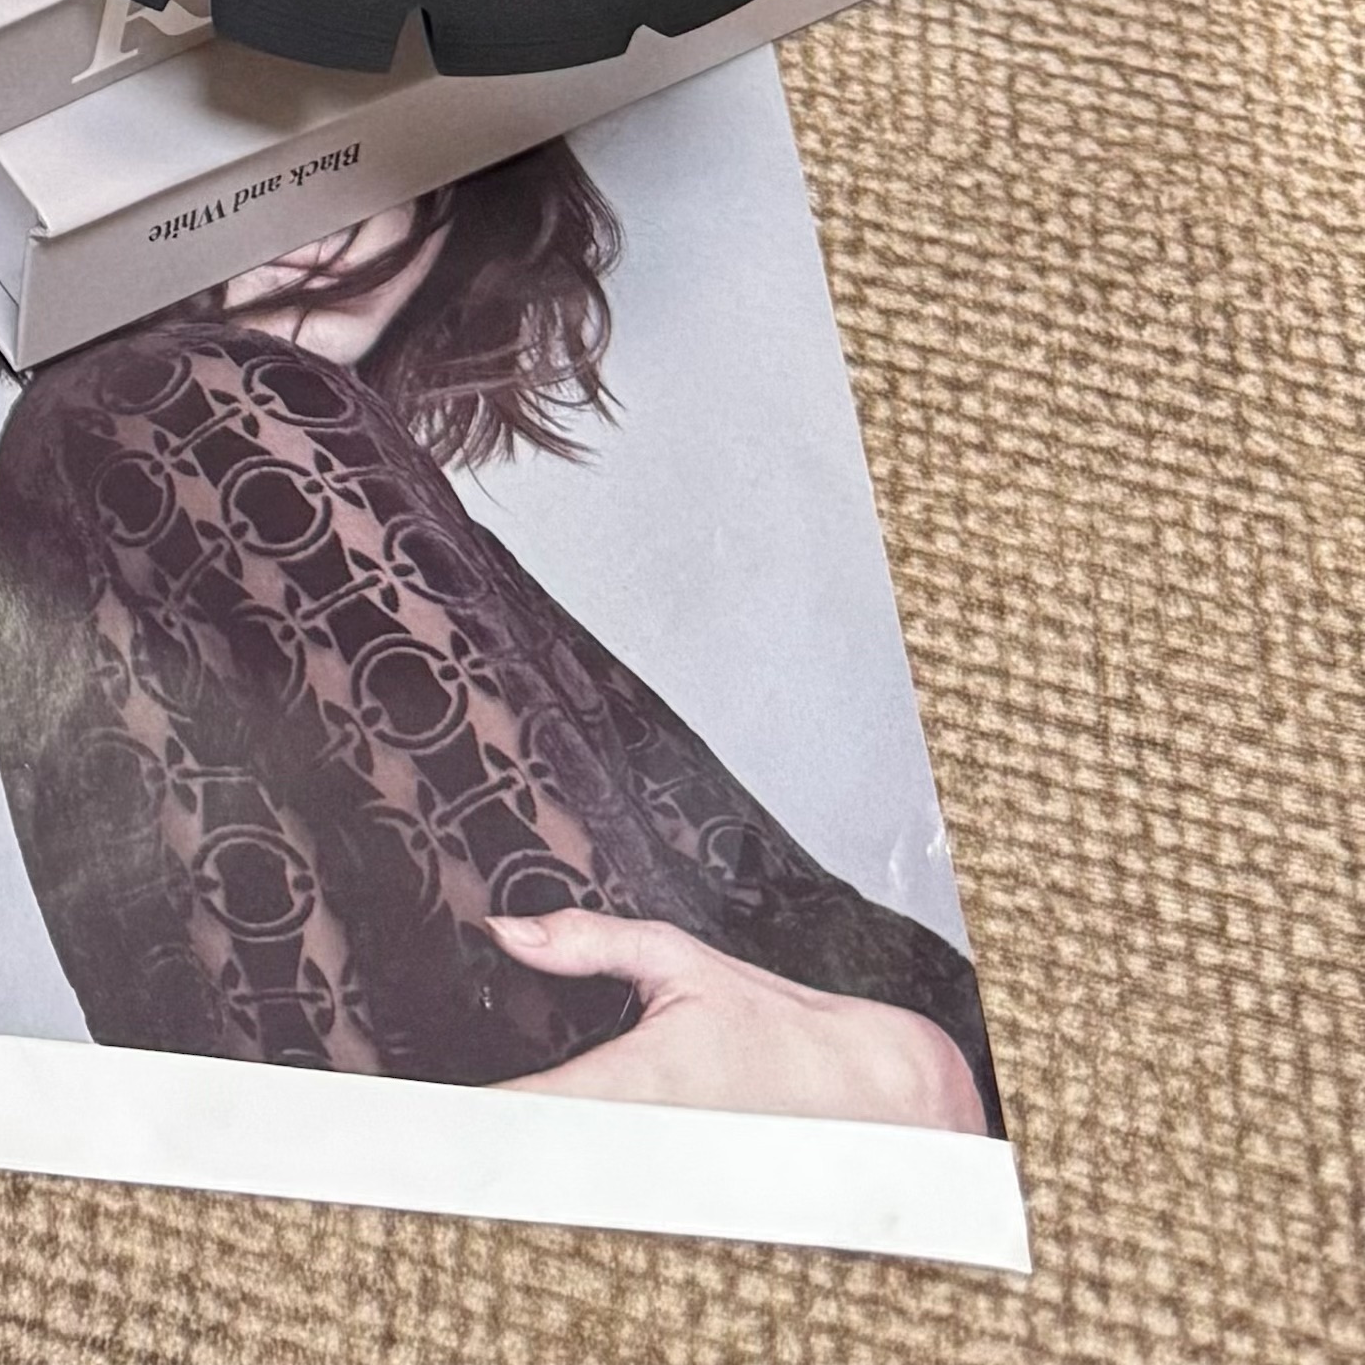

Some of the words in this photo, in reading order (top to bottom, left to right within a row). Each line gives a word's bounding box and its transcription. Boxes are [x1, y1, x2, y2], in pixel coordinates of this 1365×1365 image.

[288, 141, 362, 187] Black
[232, 174, 283, 213] and
[148, 199, 228, 243] White
